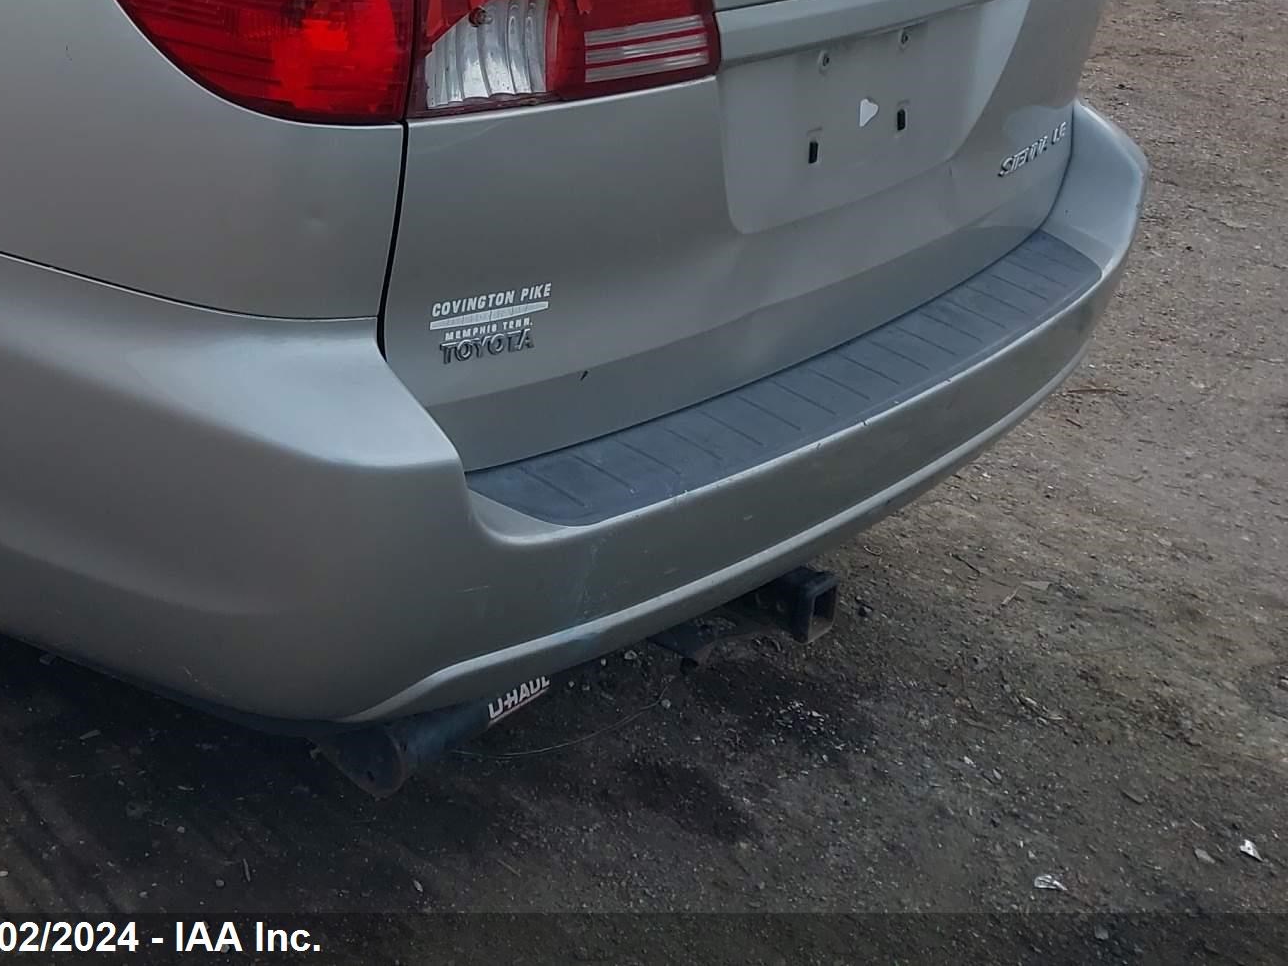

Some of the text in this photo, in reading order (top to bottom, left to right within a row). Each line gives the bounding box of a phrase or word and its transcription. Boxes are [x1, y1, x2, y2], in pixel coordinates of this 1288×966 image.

[1052, 121, 1066, 144] LE
[432, 283, 552, 317] COVINGTON PIKE
[440, 328, 534, 364] TOYOTA
[445, 323, 497, 341] MEMPHIS
[488, 676, 550, 719] U-HAUL
